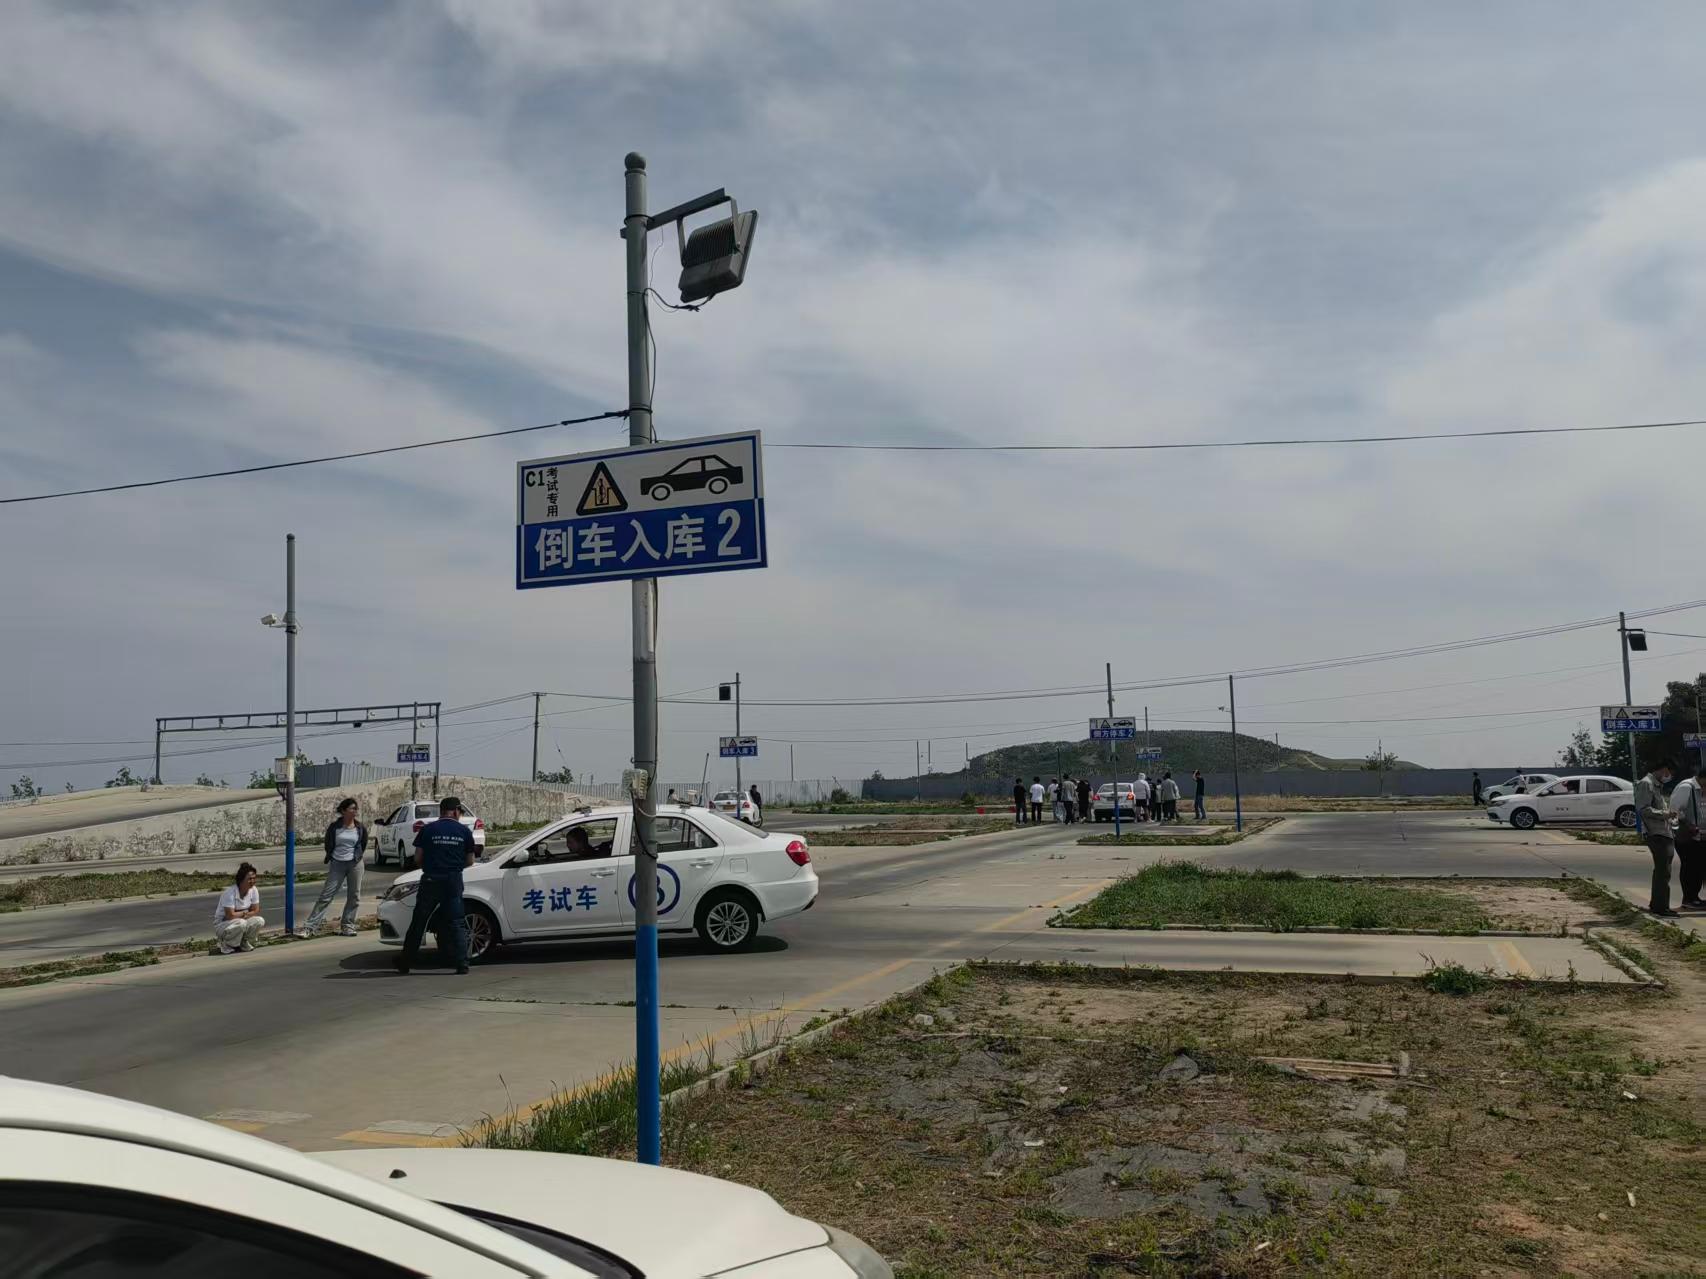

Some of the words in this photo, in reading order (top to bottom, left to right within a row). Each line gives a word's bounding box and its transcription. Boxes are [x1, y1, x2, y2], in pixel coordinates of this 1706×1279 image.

[525, 470, 545, 487] C1
[546, 467, 559, 517] 考试专用
[535, 508, 742, 571] 倒车入库2
[522, 885, 598, 914] 考试车
